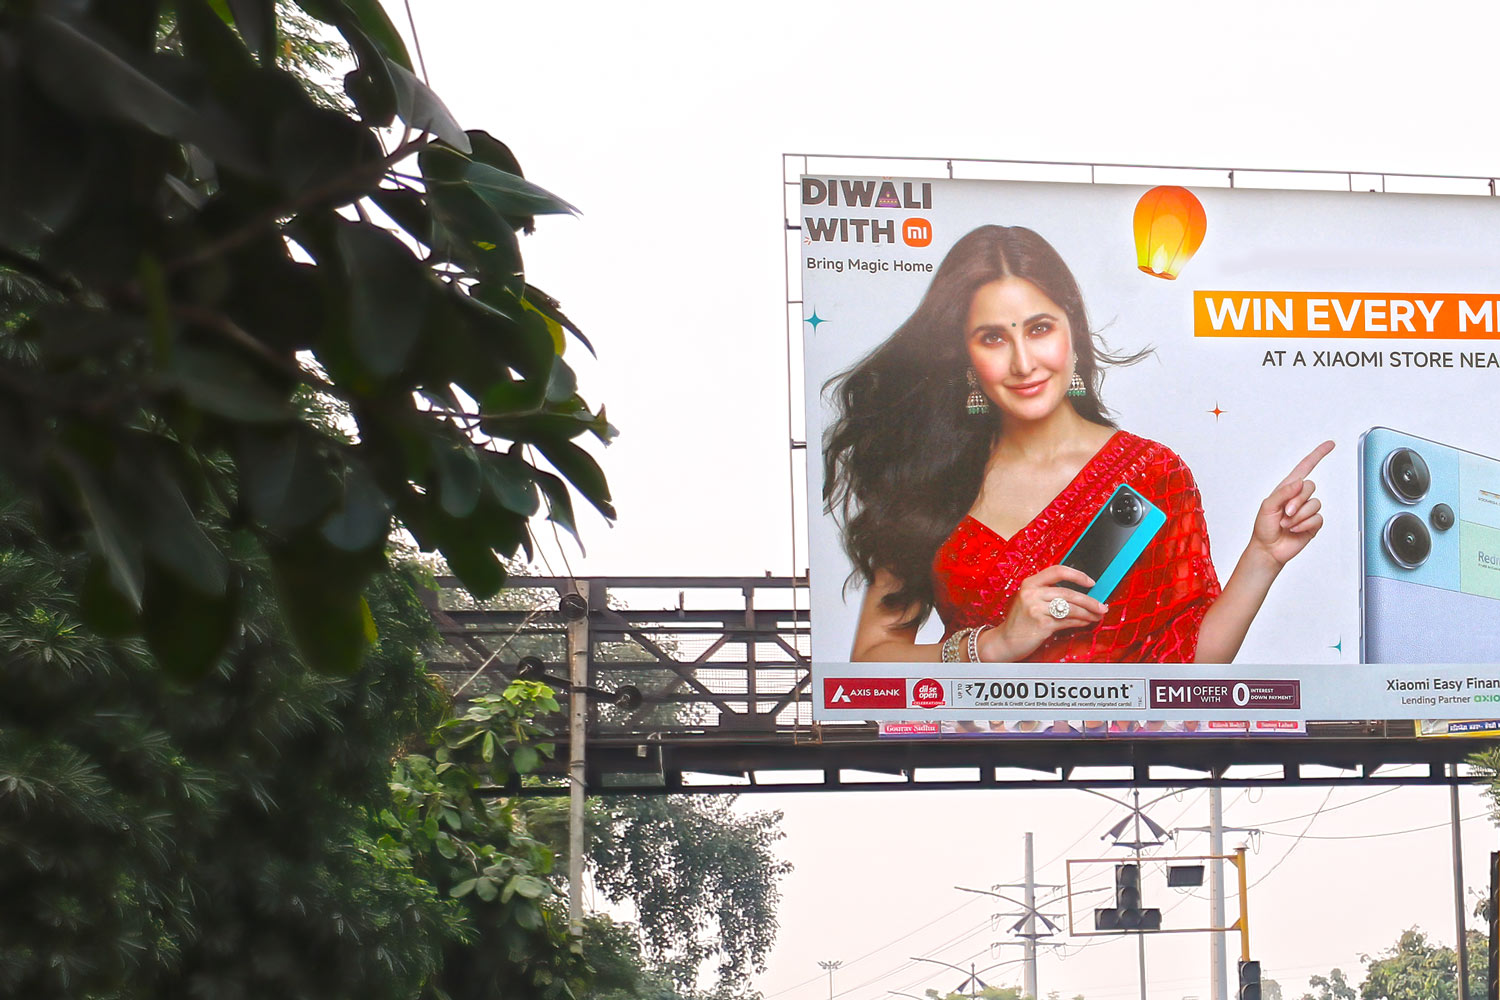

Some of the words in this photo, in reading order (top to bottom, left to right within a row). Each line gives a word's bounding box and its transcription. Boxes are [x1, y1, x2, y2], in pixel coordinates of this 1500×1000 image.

[802, 178, 933, 210] DIWALI
[805, 217, 895, 245] WITH
[806, 257, 844, 274] Bring
[848, 257, 889, 274] Magic
[893, 259, 934, 273] Home
[1204, 297, 1294, 332] WIN
[1307, 298, 1443, 333] EVERY
[1261, 350, 1287, 367] AT
[1292, 350, 1307, 367] A
[1313, 351, 1383, 367] XIAOMI
[1389, 351, 1454, 368] STORE
[919, 684, 929, 693] dil
[1387, 679, 1430, 691] Xiaomi
[1434, 679, 1462, 692] Easy
[919, 692, 938, 700] open
[1155, 686, 1192, 703] EMI
[1193, 686, 1228, 696] OFFER
[1401, 695, 1436, 706] Lending
[1438, 694, 1471, 704] Partner
